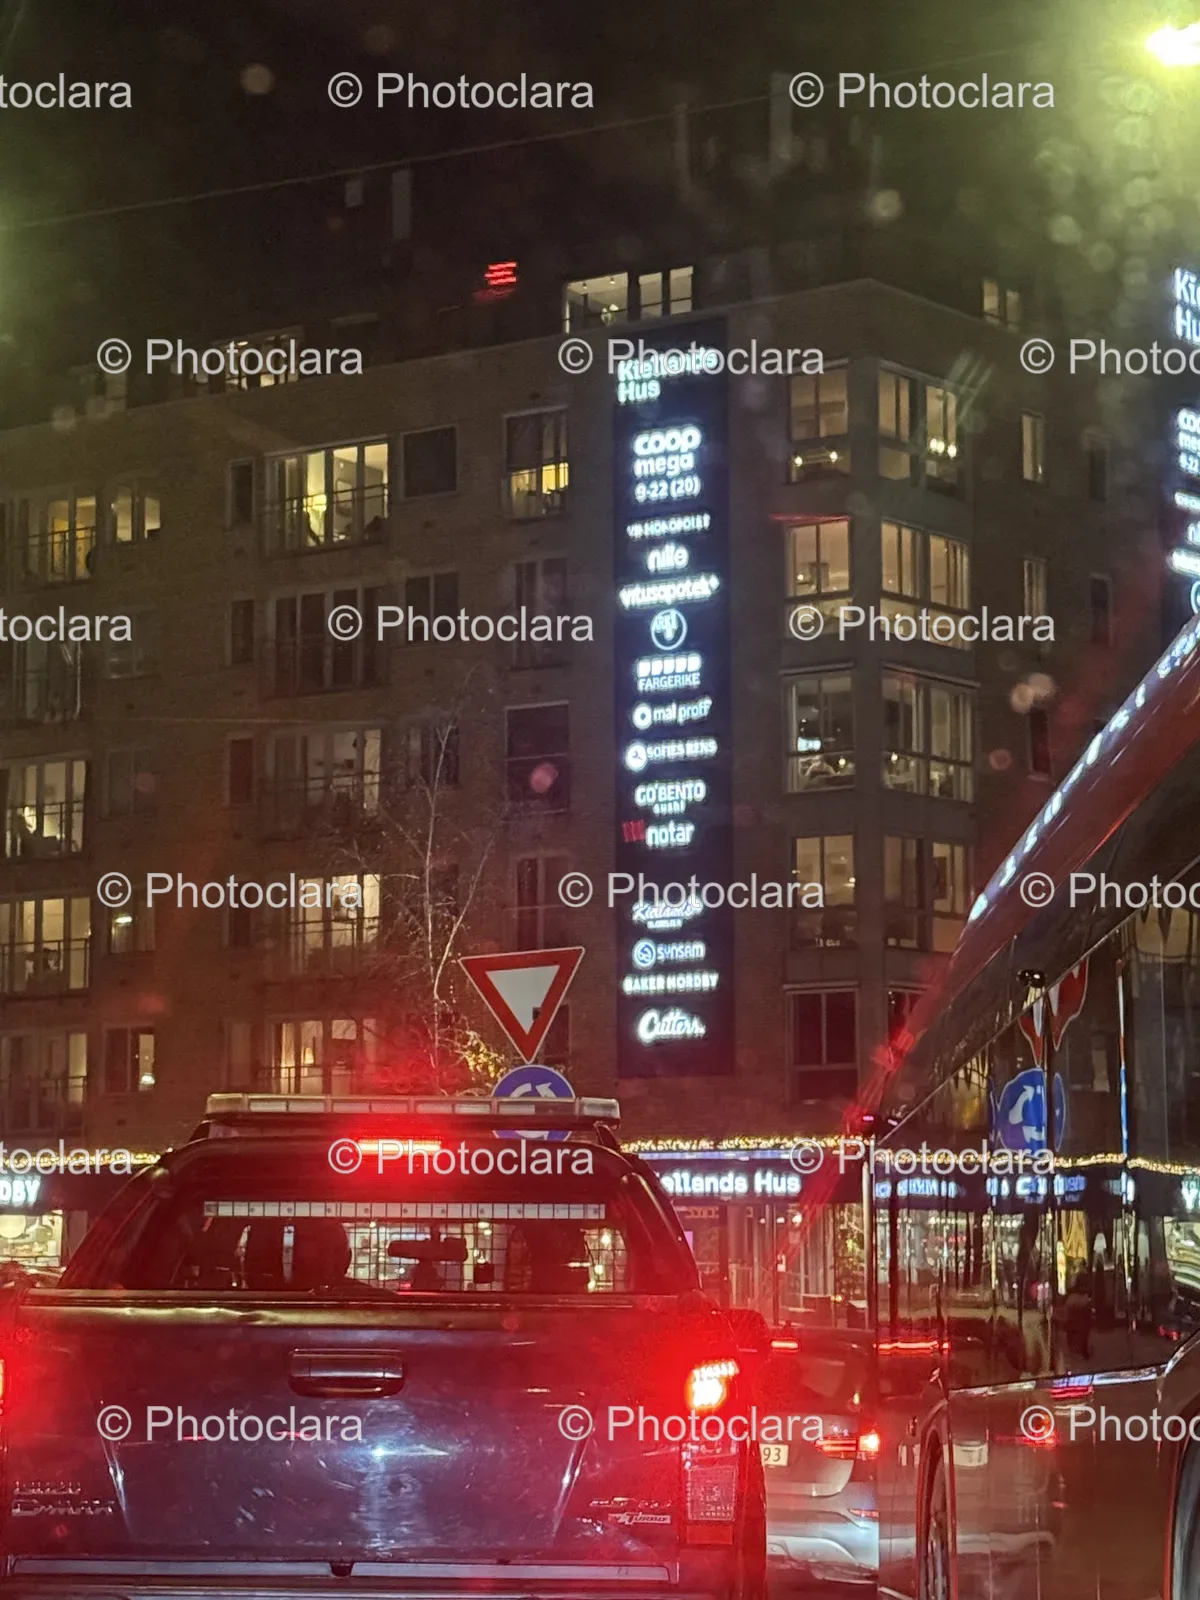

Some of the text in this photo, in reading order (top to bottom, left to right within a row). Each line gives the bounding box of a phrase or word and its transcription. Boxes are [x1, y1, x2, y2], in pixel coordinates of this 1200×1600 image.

[617, 380, 660, 404] Hus
[633, 425, 701, 456] coop
[634, 453, 695, 477] mega
[638, 672, 700, 692] FARGERIKE
[646, 822, 695, 849] notar
[655, 1171, 800, 1194] ellands Hus
